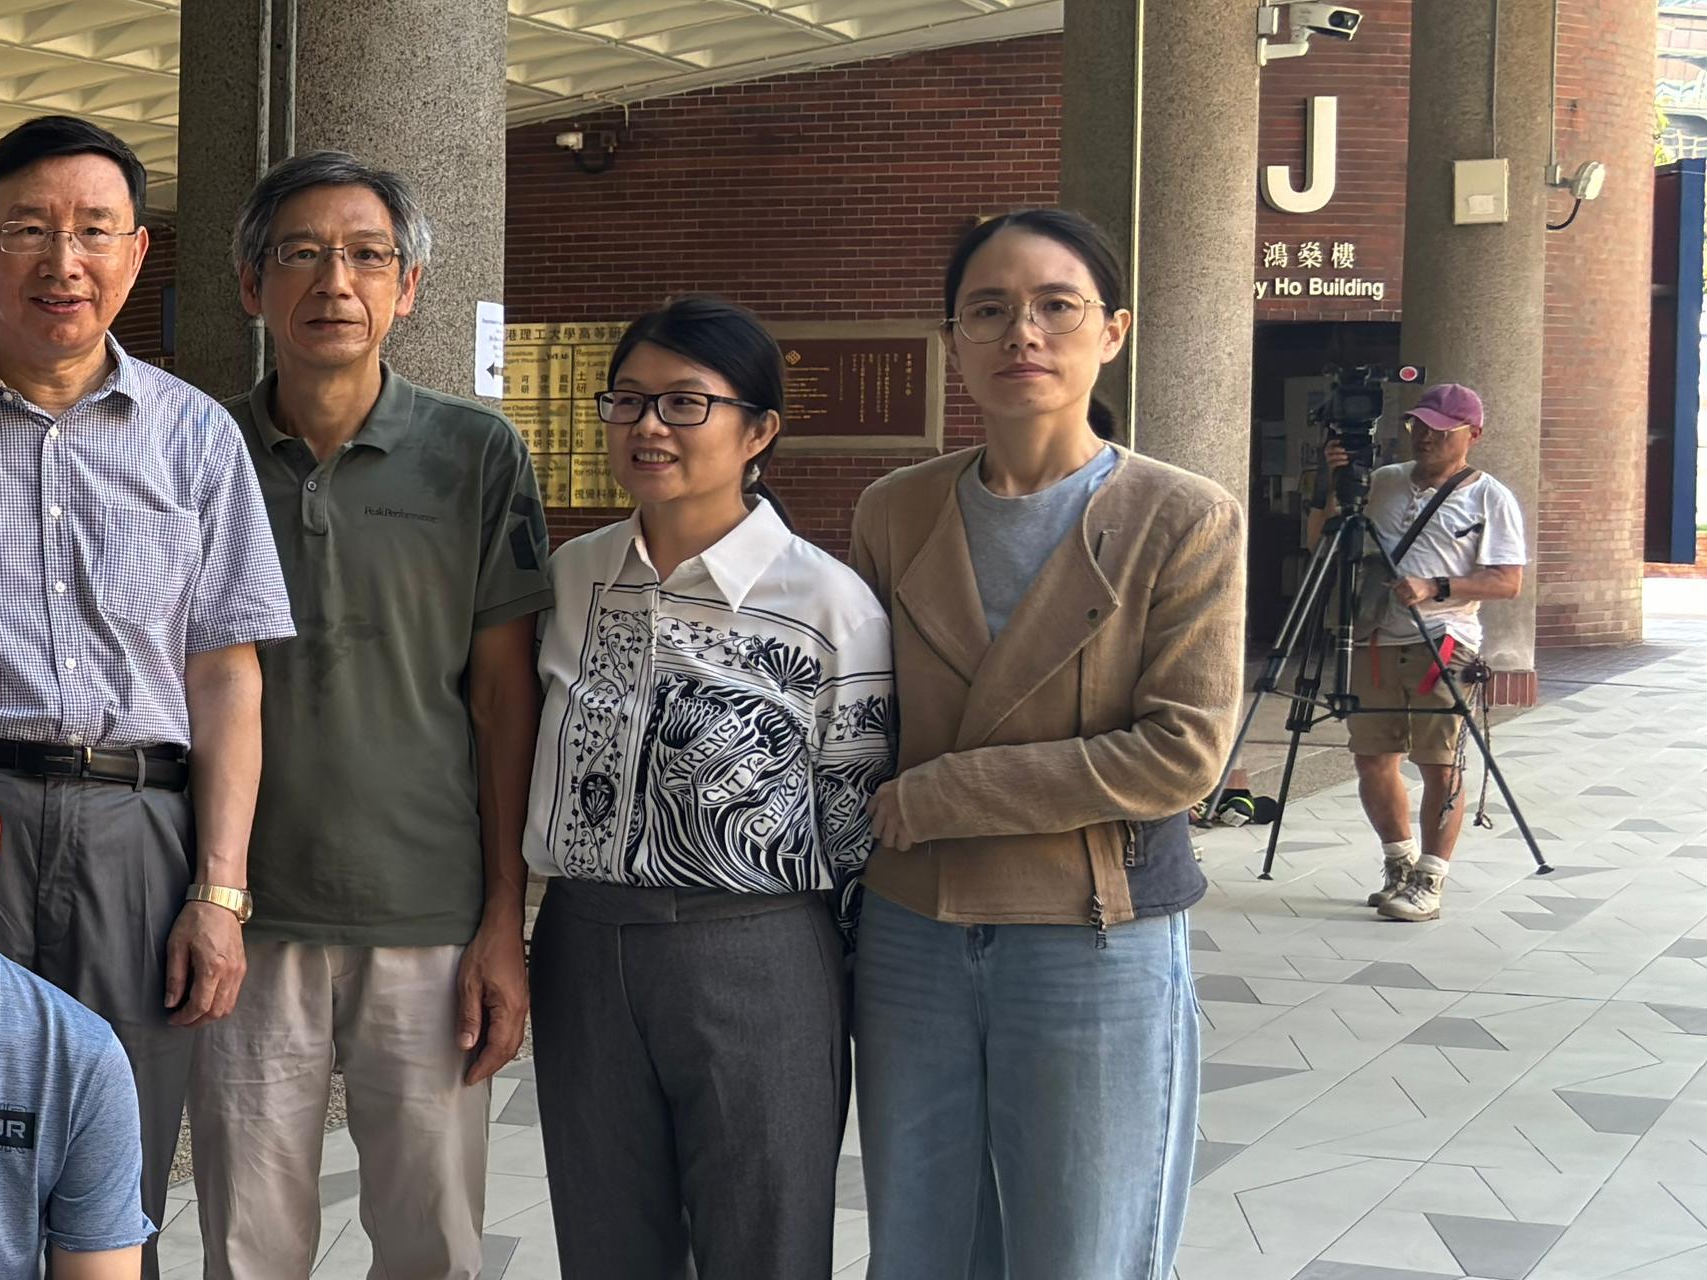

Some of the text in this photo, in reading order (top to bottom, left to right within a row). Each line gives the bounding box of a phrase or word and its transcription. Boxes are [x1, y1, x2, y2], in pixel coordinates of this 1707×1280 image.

[1260, 96, 1338, 213] J
[1275, 277, 1302, 296] Ho
[1309, 277, 1384, 301] Building
[666, 718, 738, 784] WRENS
[702, 757, 757, 803] CITY
